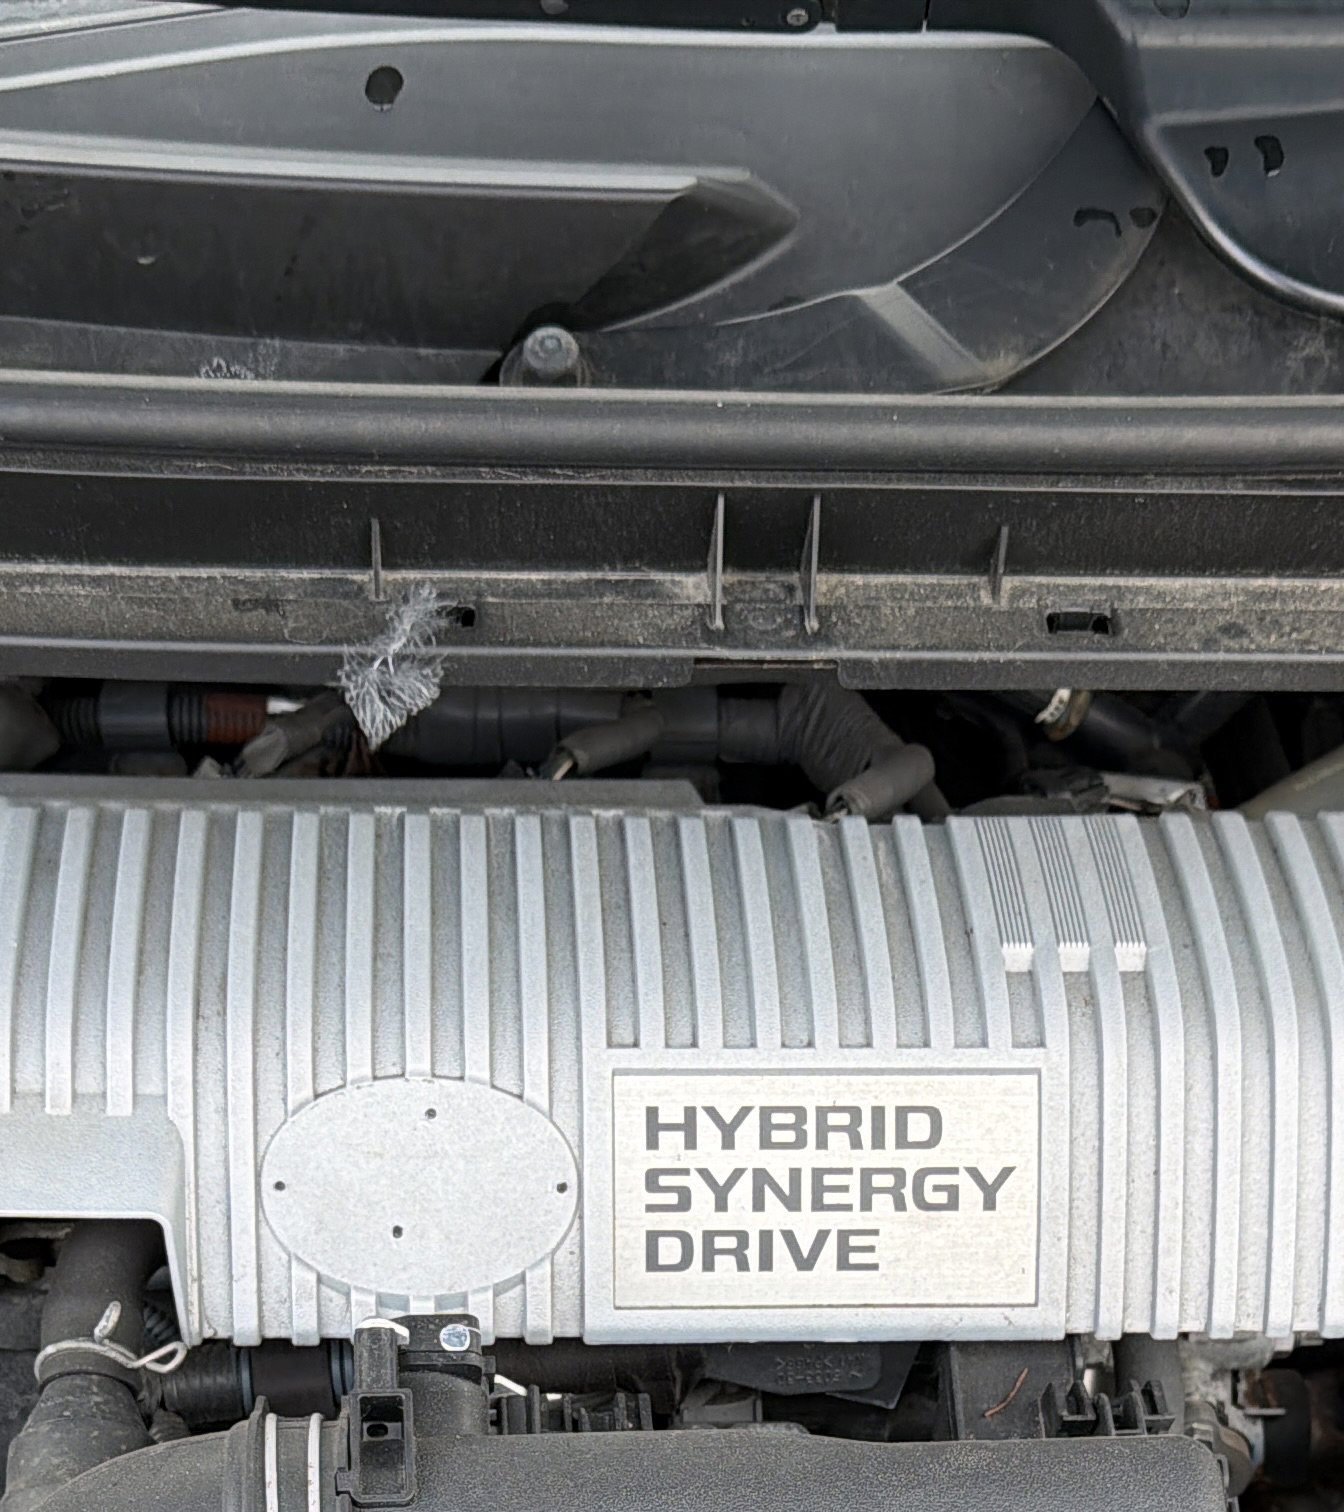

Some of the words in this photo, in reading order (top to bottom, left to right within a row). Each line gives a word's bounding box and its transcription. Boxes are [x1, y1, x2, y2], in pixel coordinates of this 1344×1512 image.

[645, 1106, 943, 1150] HYBRID
[645, 1166, 1017, 1213] SYNERGY
[645, 1229, 880, 1272] DRIVE
